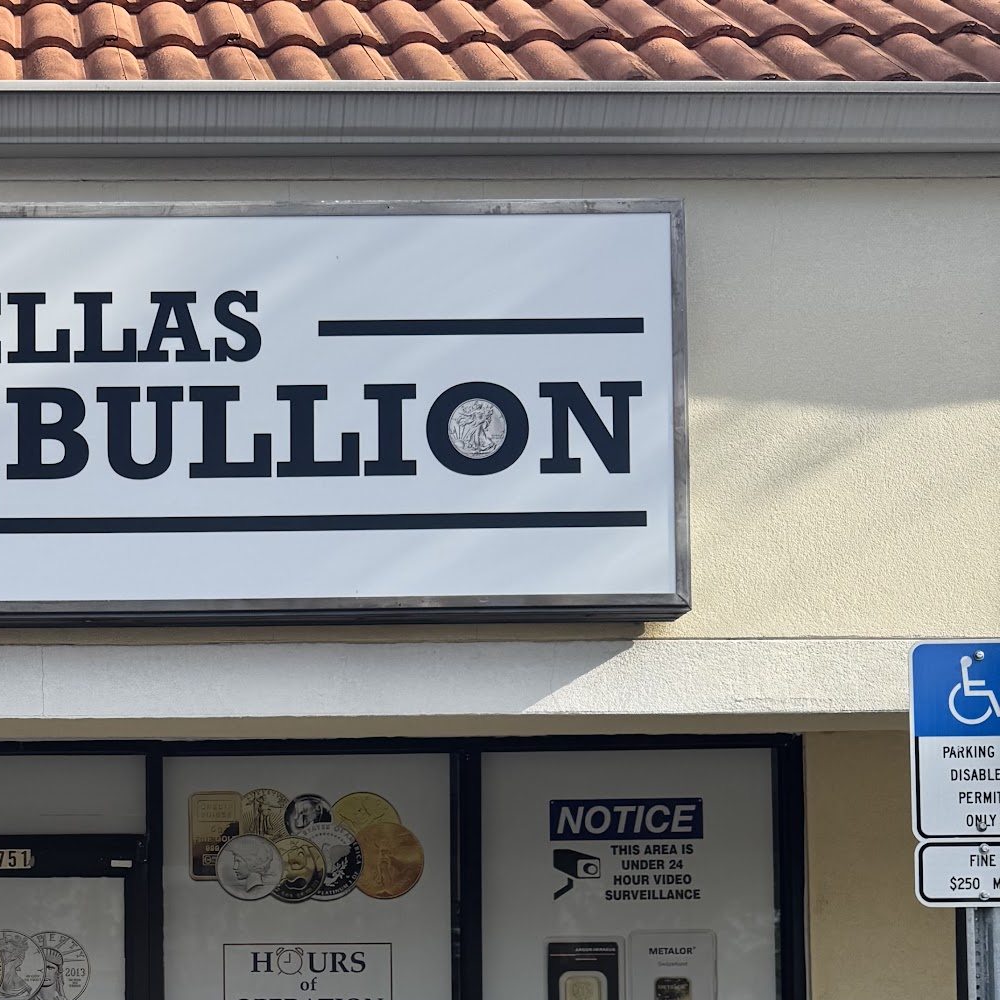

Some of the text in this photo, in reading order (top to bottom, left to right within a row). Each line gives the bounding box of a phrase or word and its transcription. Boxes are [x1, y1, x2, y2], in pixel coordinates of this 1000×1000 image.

[6, 379, 645, 480] BULLION
[943, 745, 995, 759] PARKING
[556, 804, 696, 834] NOTICE
[966, 814, 996, 826] ONLY
[611, 844, 693, 856] THIS AREA IS
[622, 860, 684, 871] UNDER 24
[970, 855, 996, 866] FINE
[614, 875, 692, 886] HOUR VIDEO
[950, 877, 980, 891] $250
[605, 890, 701, 901] SURVEILLANCE
[65, 969, 86, 977] 2013
[300, 977, 317, 991] of
